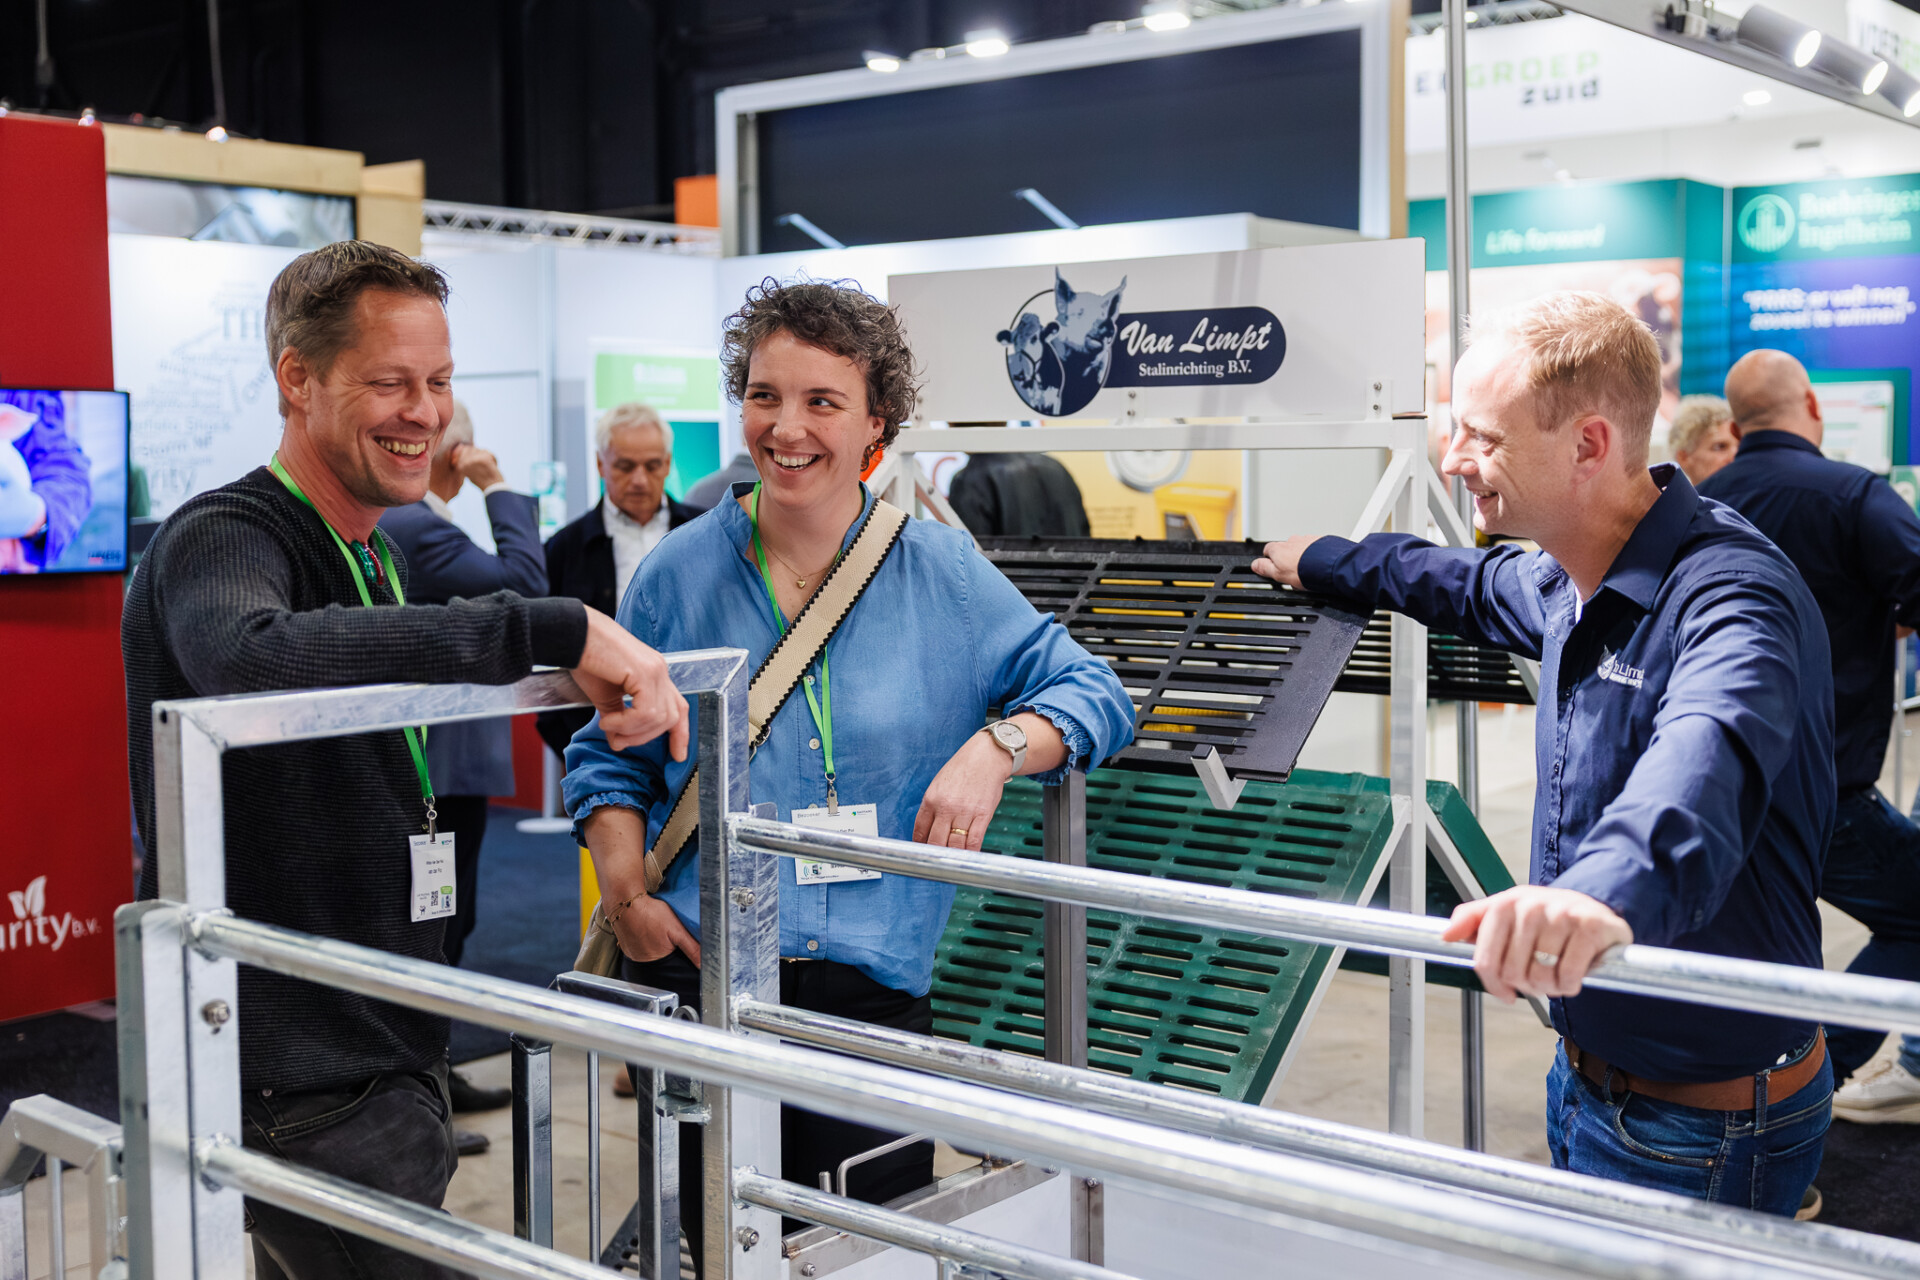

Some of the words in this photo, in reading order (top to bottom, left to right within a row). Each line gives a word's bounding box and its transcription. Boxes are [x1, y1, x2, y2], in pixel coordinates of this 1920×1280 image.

[1521, 75, 1598, 105] zuid
[1120, 320, 1174, 356] Van
[1179, 317, 1272, 359] Limpt
[1139, 361, 1224, 377] Stalinrichting
[1228, 359, 1252, 374] B.V.
